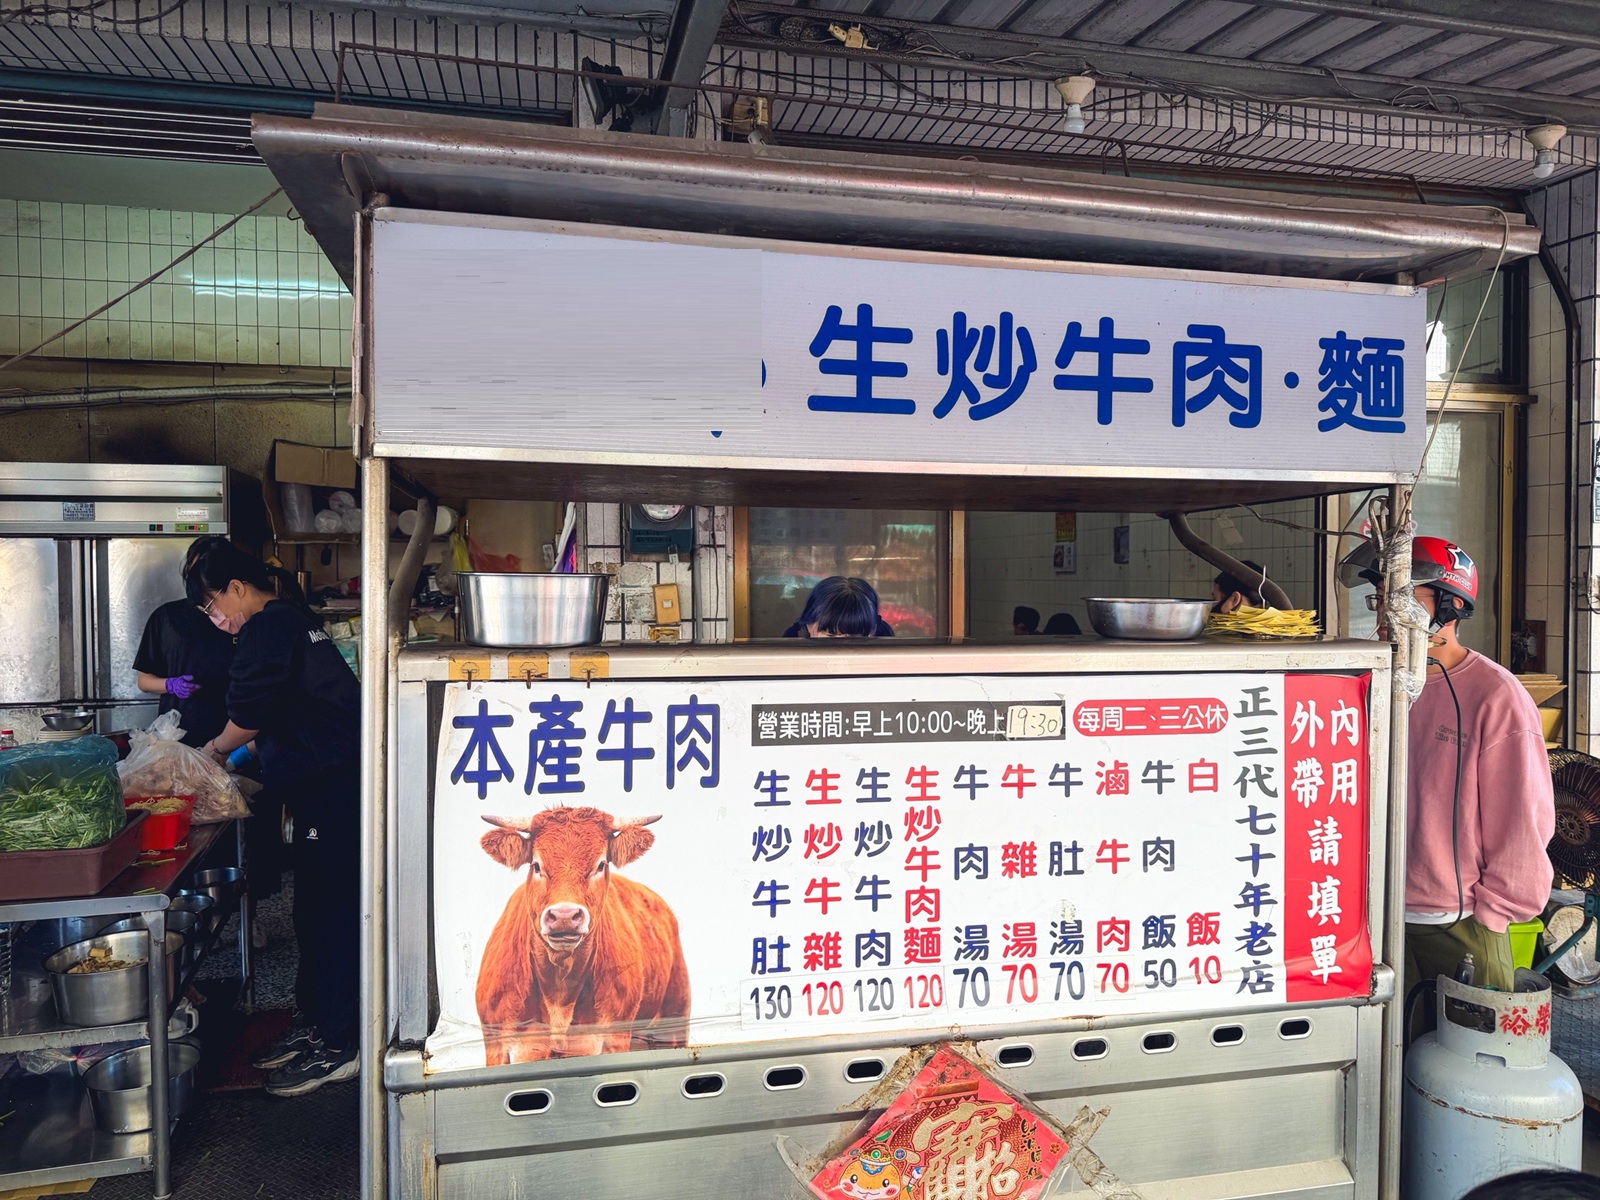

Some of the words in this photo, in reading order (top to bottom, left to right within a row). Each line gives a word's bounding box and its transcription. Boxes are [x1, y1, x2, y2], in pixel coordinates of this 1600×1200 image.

[450, 694, 720, 800] 本產牛肉
[1076, 704, 1228, 733] 每周二、三公休
[1290, 699, 1325, 809] 外帶
[1329, 699, 1359, 806] 內用
[751, 769, 791, 975] 生炒牛肚
[803, 767, 842, 972] 生炒牛雜
[854, 766, 892, 968] 生炒牛肉
[904, 765, 942, 965] 生炒牛肉麵
[952, 764, 989, 961] 牛肉湯
[1001, 763, 1037, 958] 牛雜湯
[1049, 762, 1084, 955] 牛肚湯
[1096, 760, 1131, 953] 滷牛肉
[1141, 759, 1176, 950] 牛肉飯
[1187, 757, 1220, 947] 白飯
[1233, 686, 1278, 995] 正三代七十年老店
[1307, 816, 1343, 985] 請填單
[750, 984, 792, 1021] 130
[801, 980, 844, 1016] 120
[853, 976, 894, 1012] 120
[903, 973, 943, 1009] 120
[952, 967, 990, 1008] 70
[1001, 963, 1038, 1003] 70
[1049, 961, 1085, 1000] 70
[1097, 962, 1130, 993] 70
[1144, 958, 1177, 988] 50
[1188, 955, 1222, 984] 10
